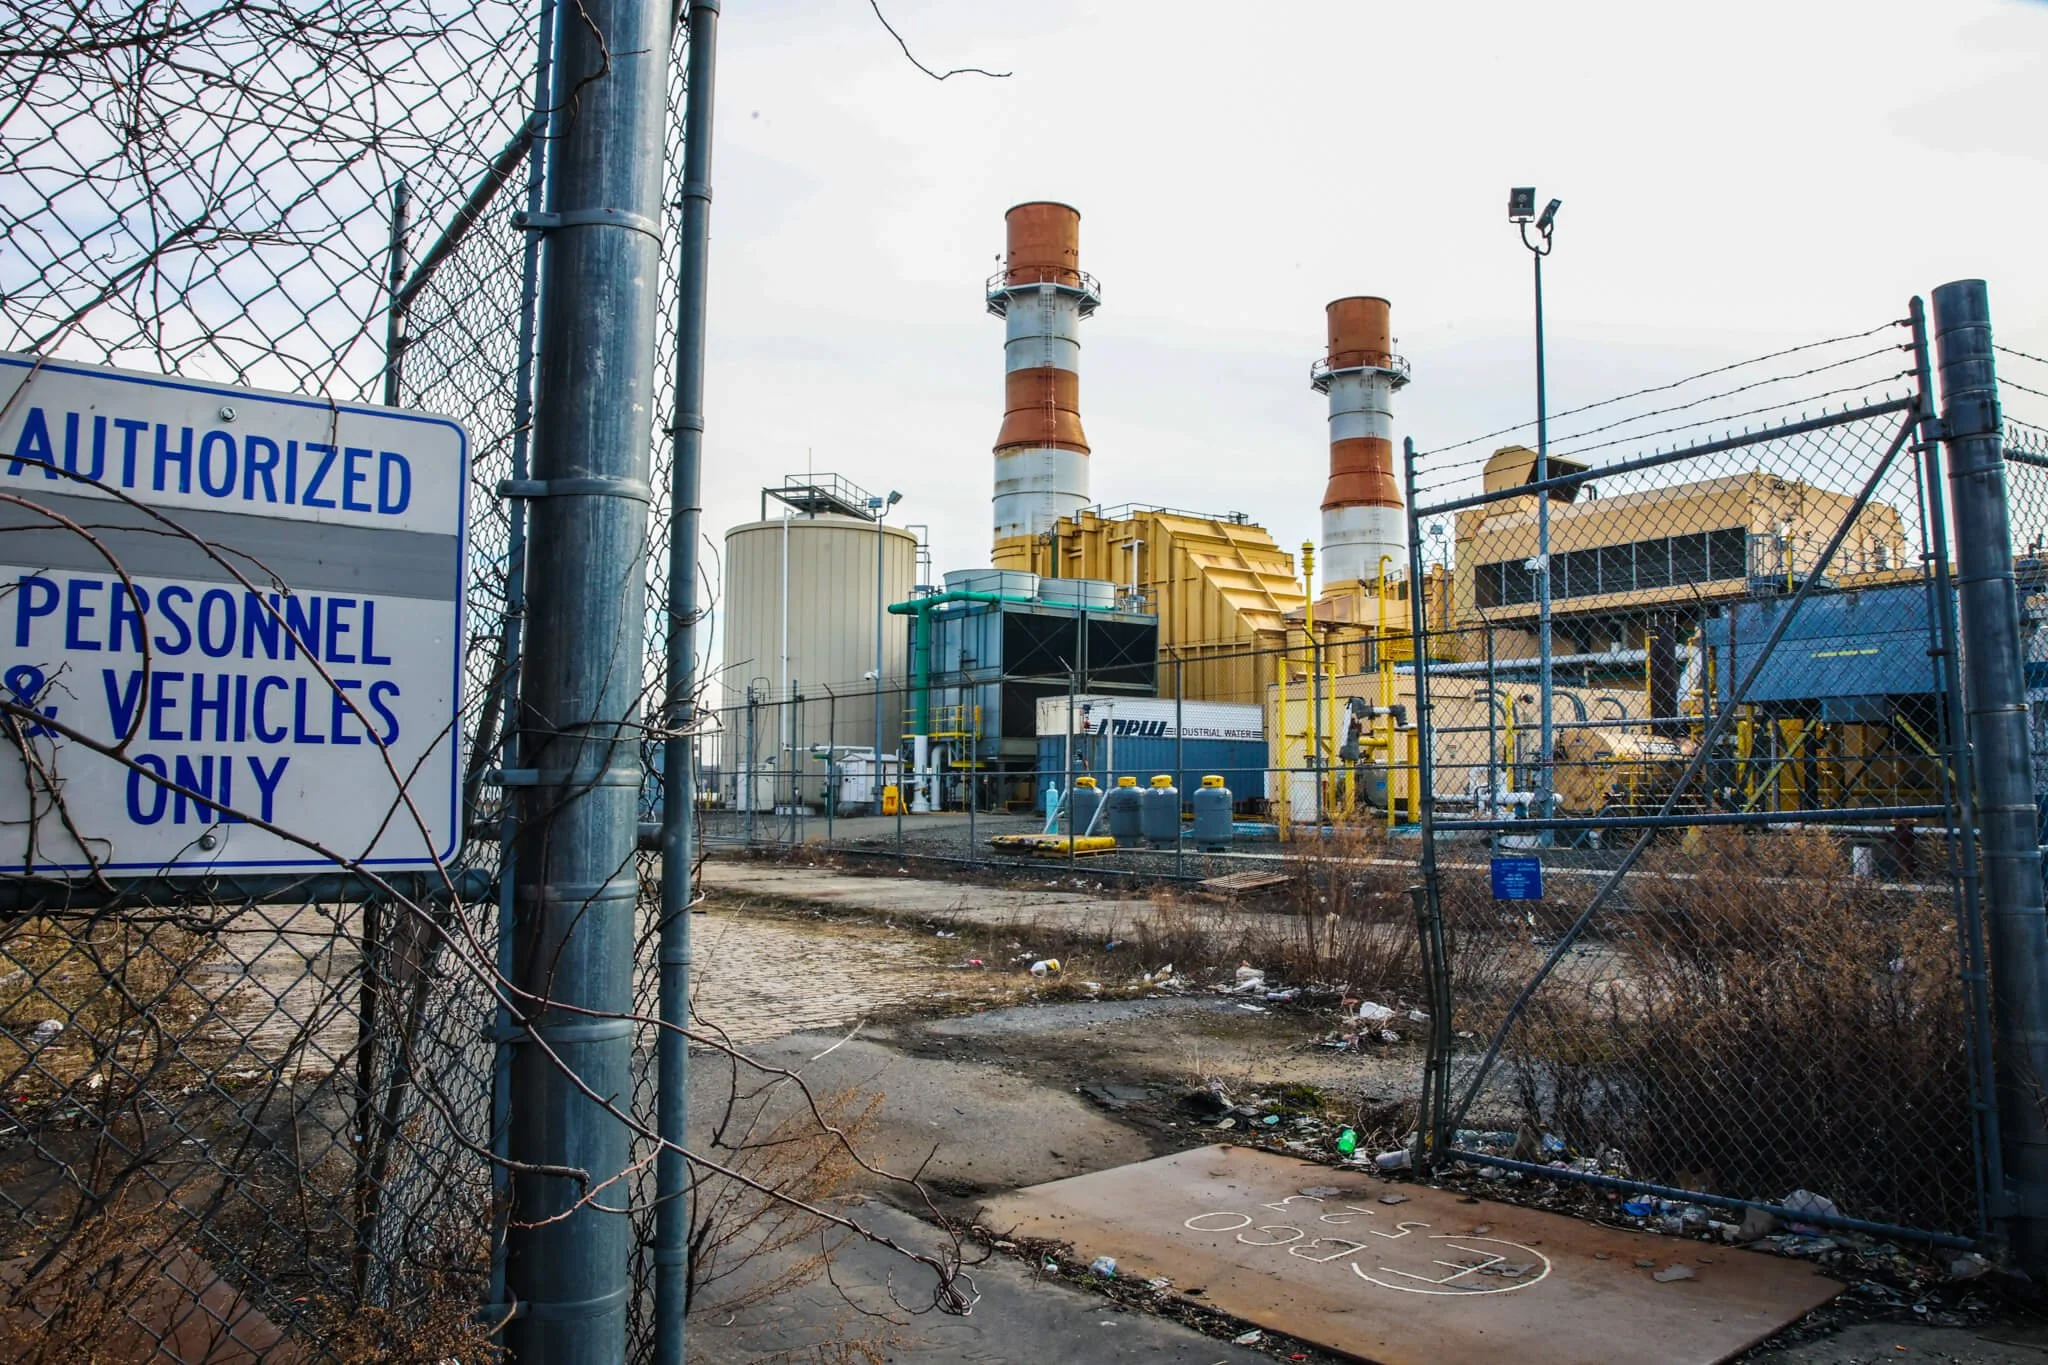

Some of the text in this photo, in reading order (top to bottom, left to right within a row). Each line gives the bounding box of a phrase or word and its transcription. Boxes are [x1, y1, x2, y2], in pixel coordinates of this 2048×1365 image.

[7, 407, 411, 514] AUTHORIZED
[15, 576, 392, 665] PERSONNEL
[102, 669, 401, 745] VEHICLES
[1224, 729, 1251, 738] WATER
[126, 753, 290, 824] ONLY
